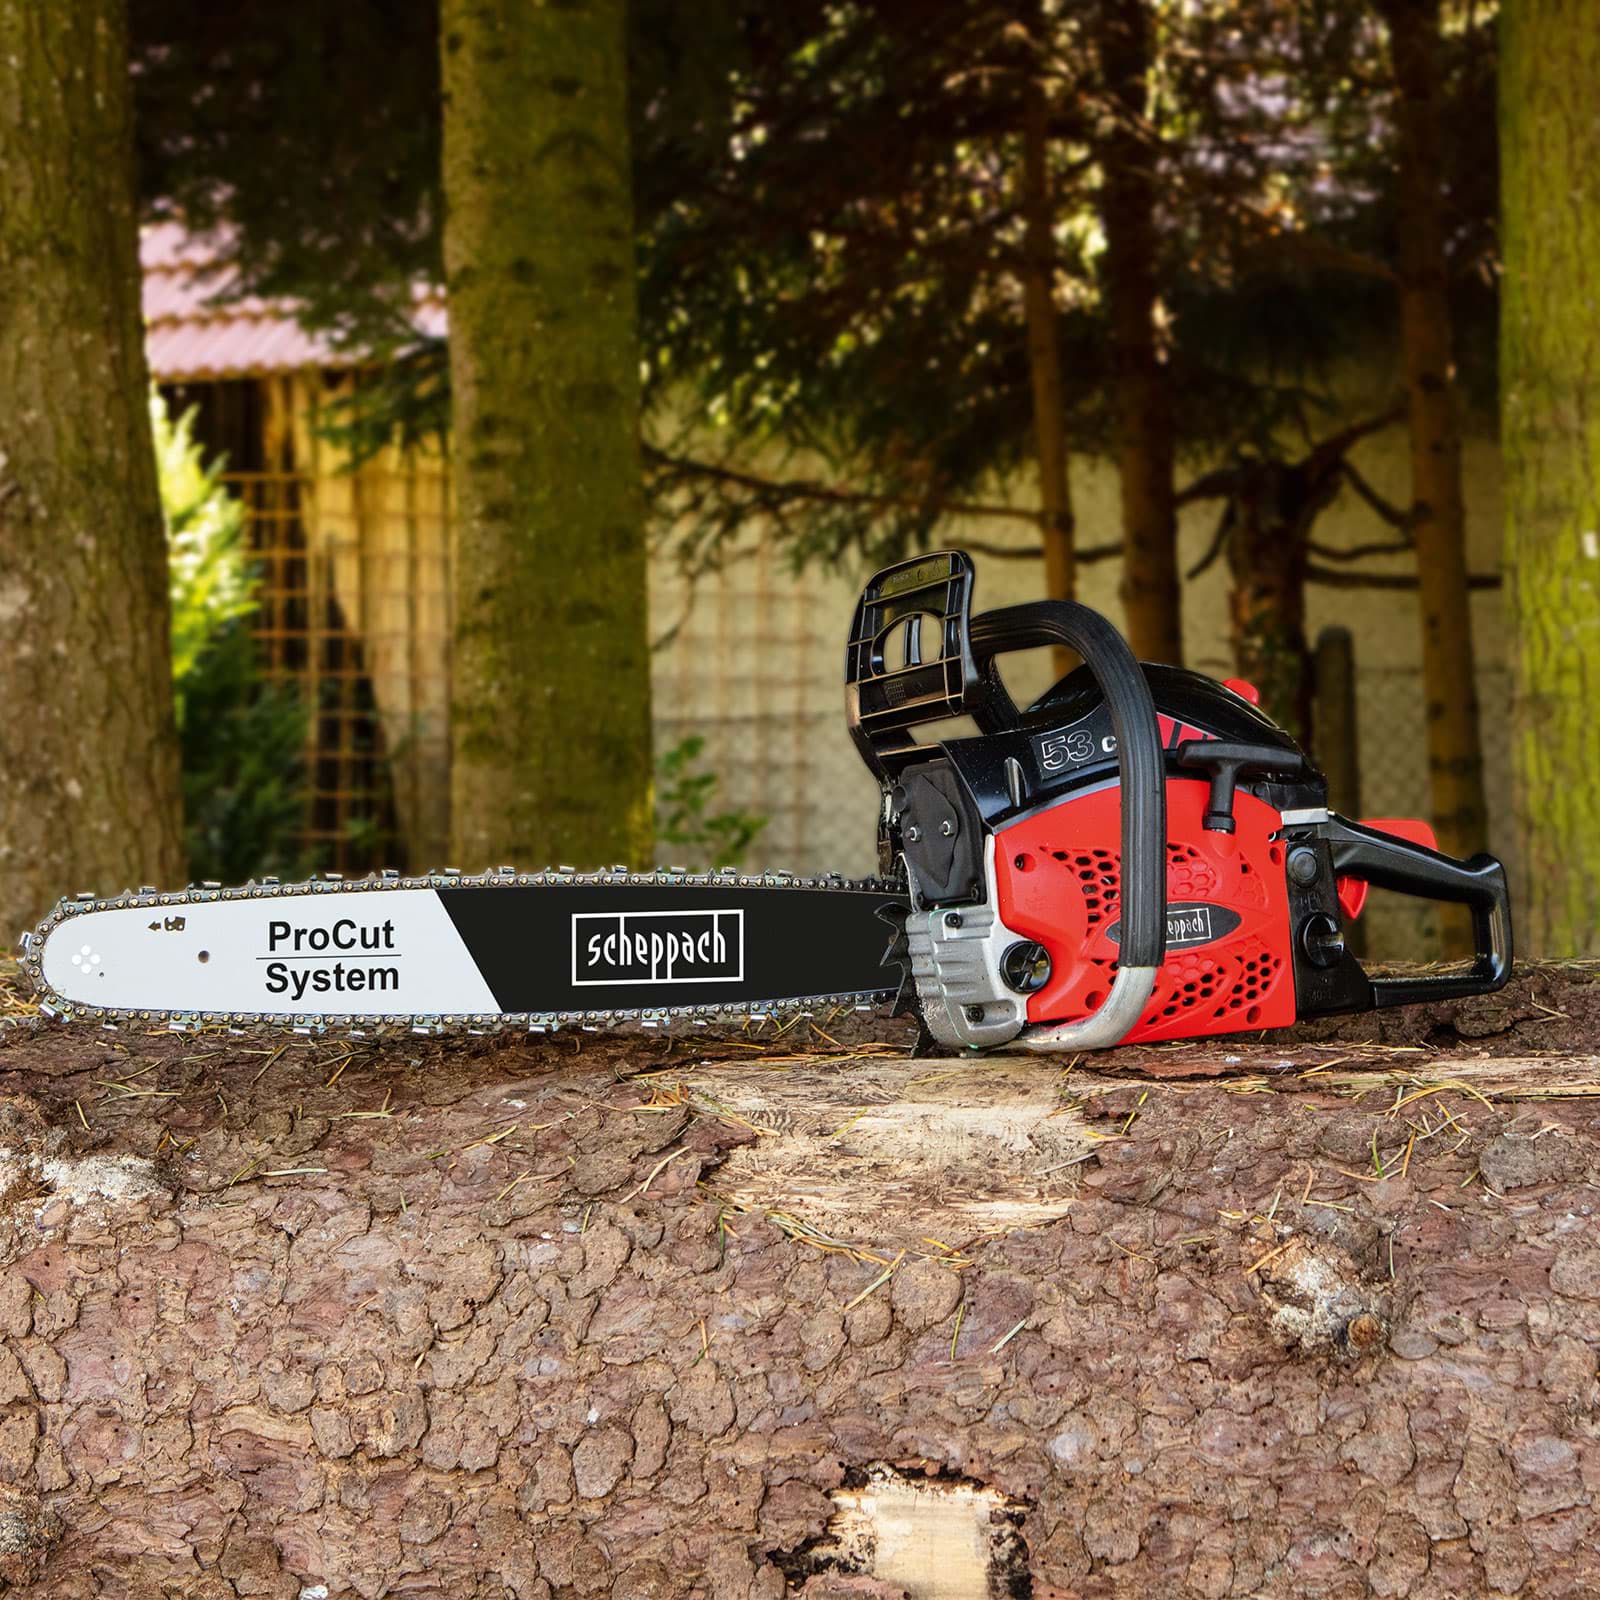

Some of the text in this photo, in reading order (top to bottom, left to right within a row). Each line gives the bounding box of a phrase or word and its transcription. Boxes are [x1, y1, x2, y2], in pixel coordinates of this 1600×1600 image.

[1041, 729, 1118, 771] 53 c
[268, 918, 395, 952] ProCut
[1166, 909, 1205, 941] eppach
[588, 913, 727, 981] scheppach
[265, 962, 399, 1001] System
